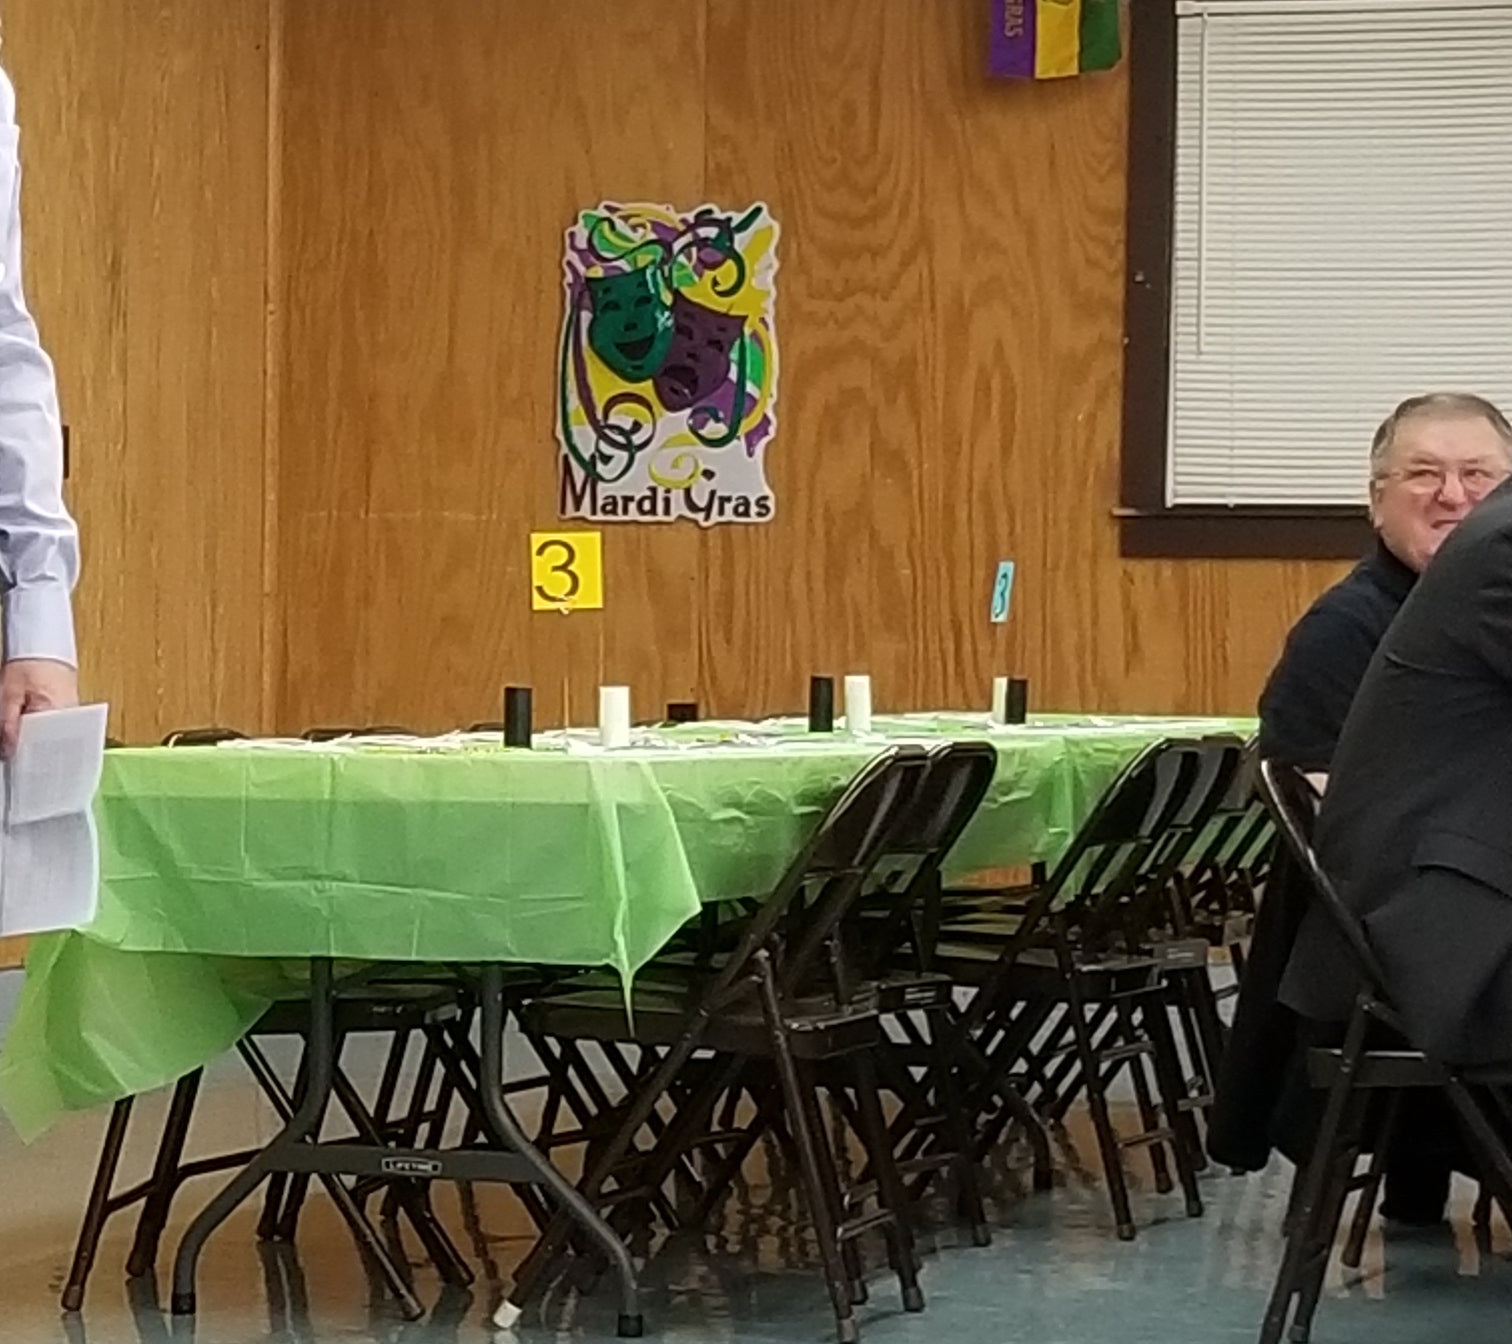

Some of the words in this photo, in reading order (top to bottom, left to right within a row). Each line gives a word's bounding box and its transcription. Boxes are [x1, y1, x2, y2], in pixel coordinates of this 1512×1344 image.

[559, 453, 672, 517] Mardi
[683, 468, 773, 522] Gras
[535, 539, 580, 603] 3
